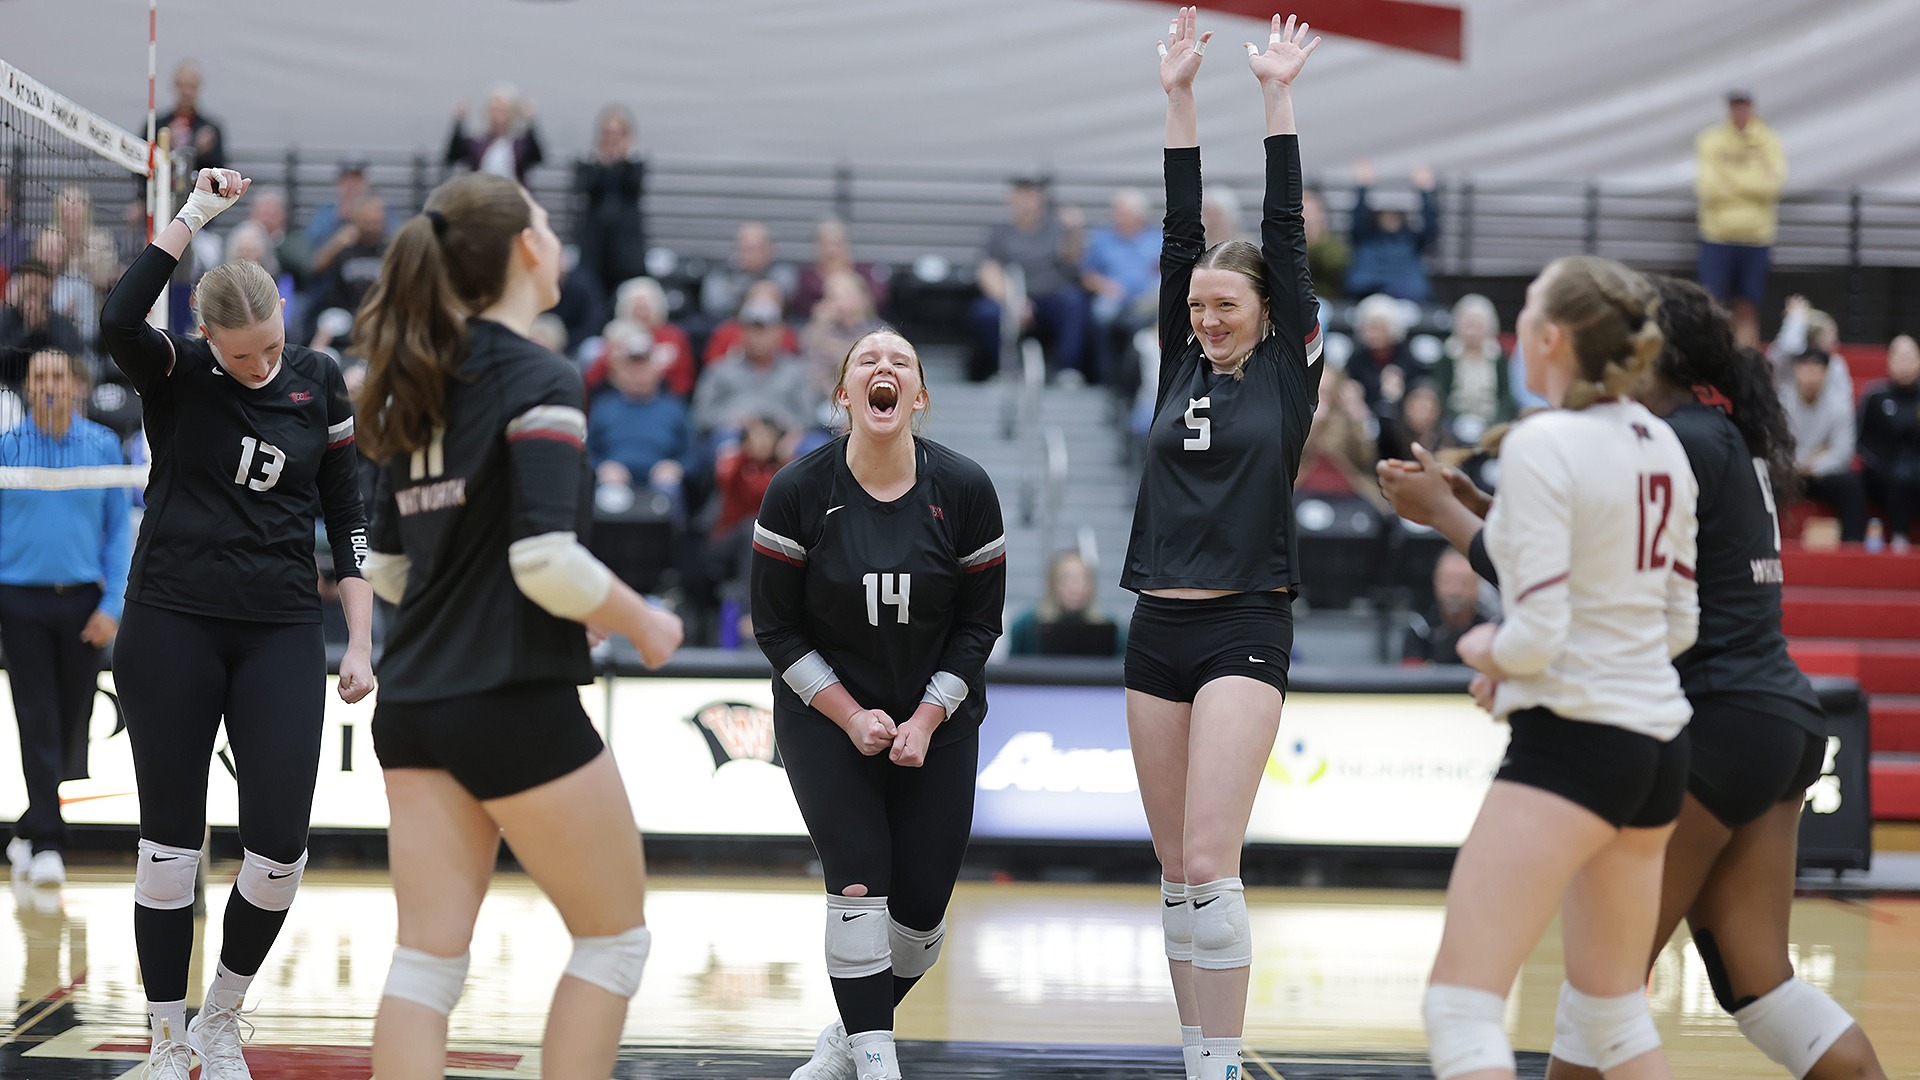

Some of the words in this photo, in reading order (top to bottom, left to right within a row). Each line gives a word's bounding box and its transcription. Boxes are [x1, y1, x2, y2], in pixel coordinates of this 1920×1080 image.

[1183, 396, 1211, 451] 5
[234, 436, 287, 492] 13
[1637, 472, 1672, 571] 12
[862, 572, 911, 627] 14
